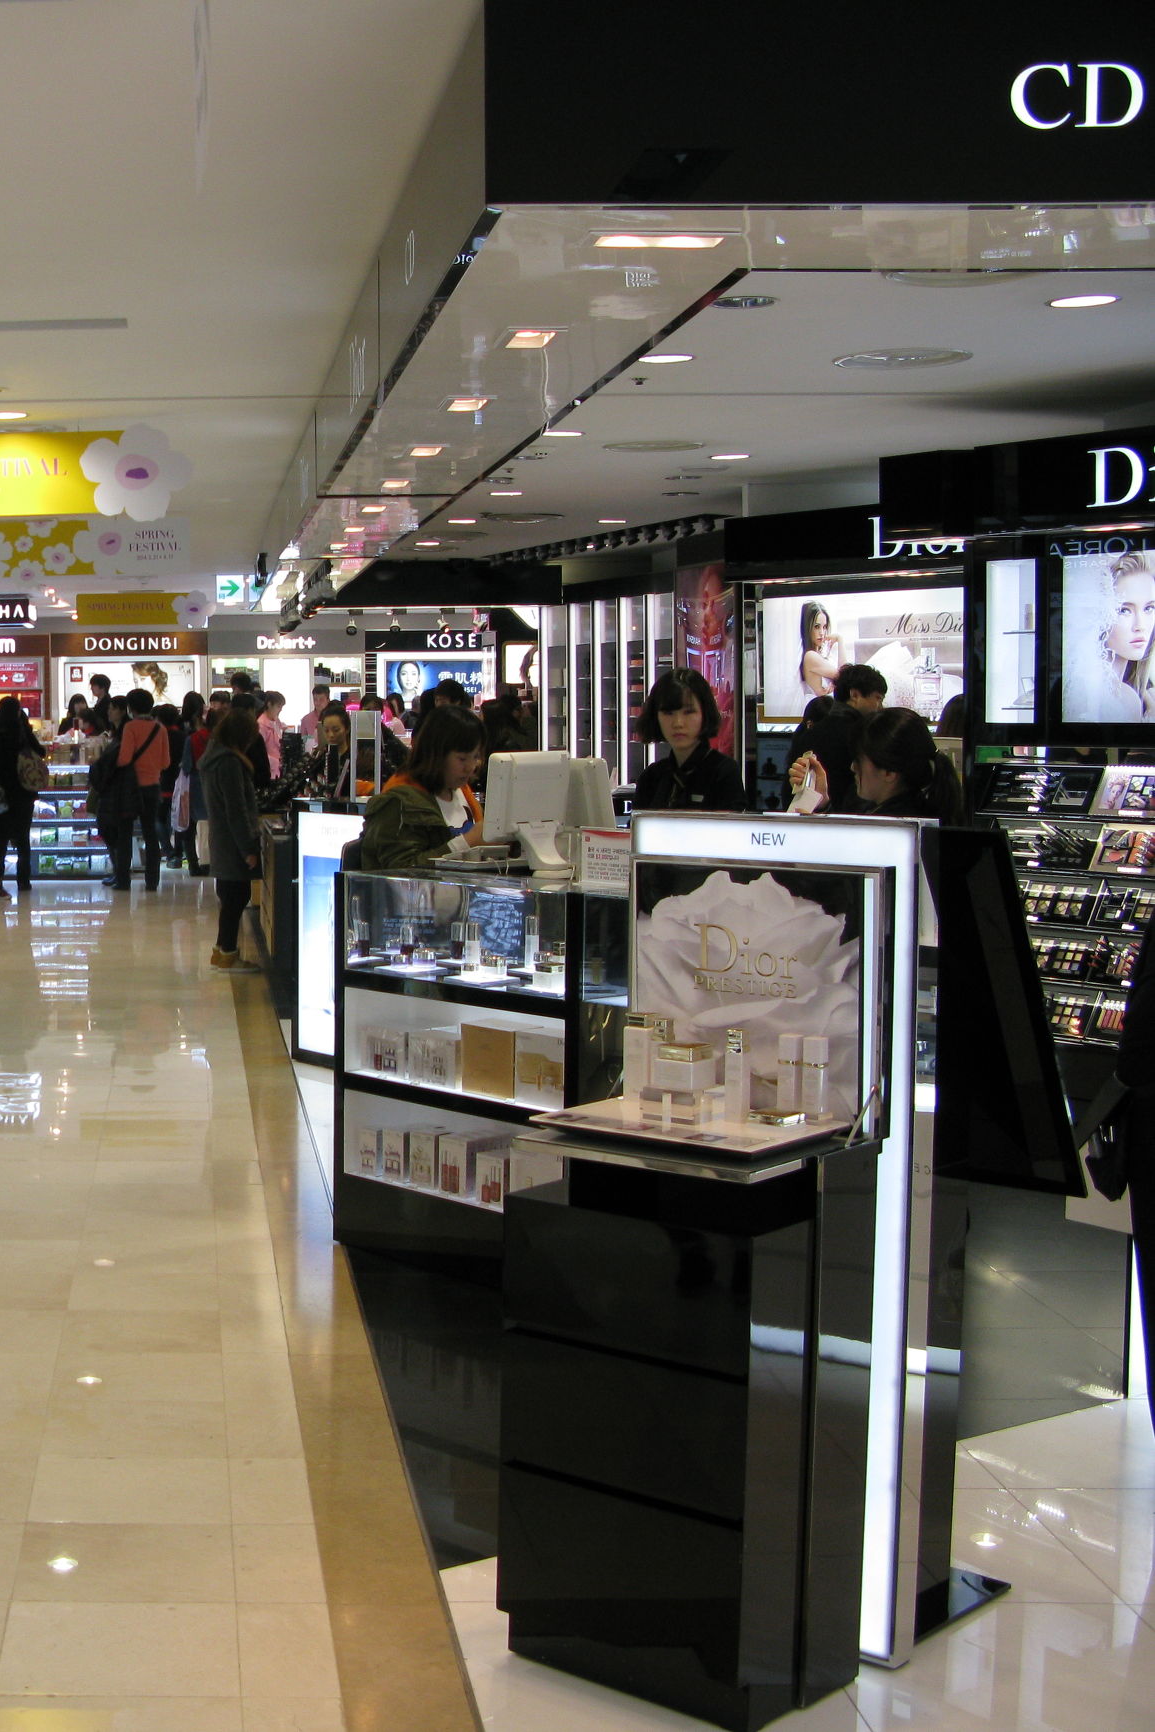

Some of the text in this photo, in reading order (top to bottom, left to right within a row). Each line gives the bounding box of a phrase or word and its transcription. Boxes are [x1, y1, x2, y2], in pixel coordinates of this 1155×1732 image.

[1010, 62, 1145, 129] CD
[134, 529, 175, 540] SPRING
[128, 541, 181, 553] FESTIVAL
[885, 612, 930, 635] Miss
[84, 637, 178, 651] DONGINBI
[751, 832, 786, 846] NEW
[693, 922, 798, 979] Dior
[693, 974, 798, 999] PRESTIGE
